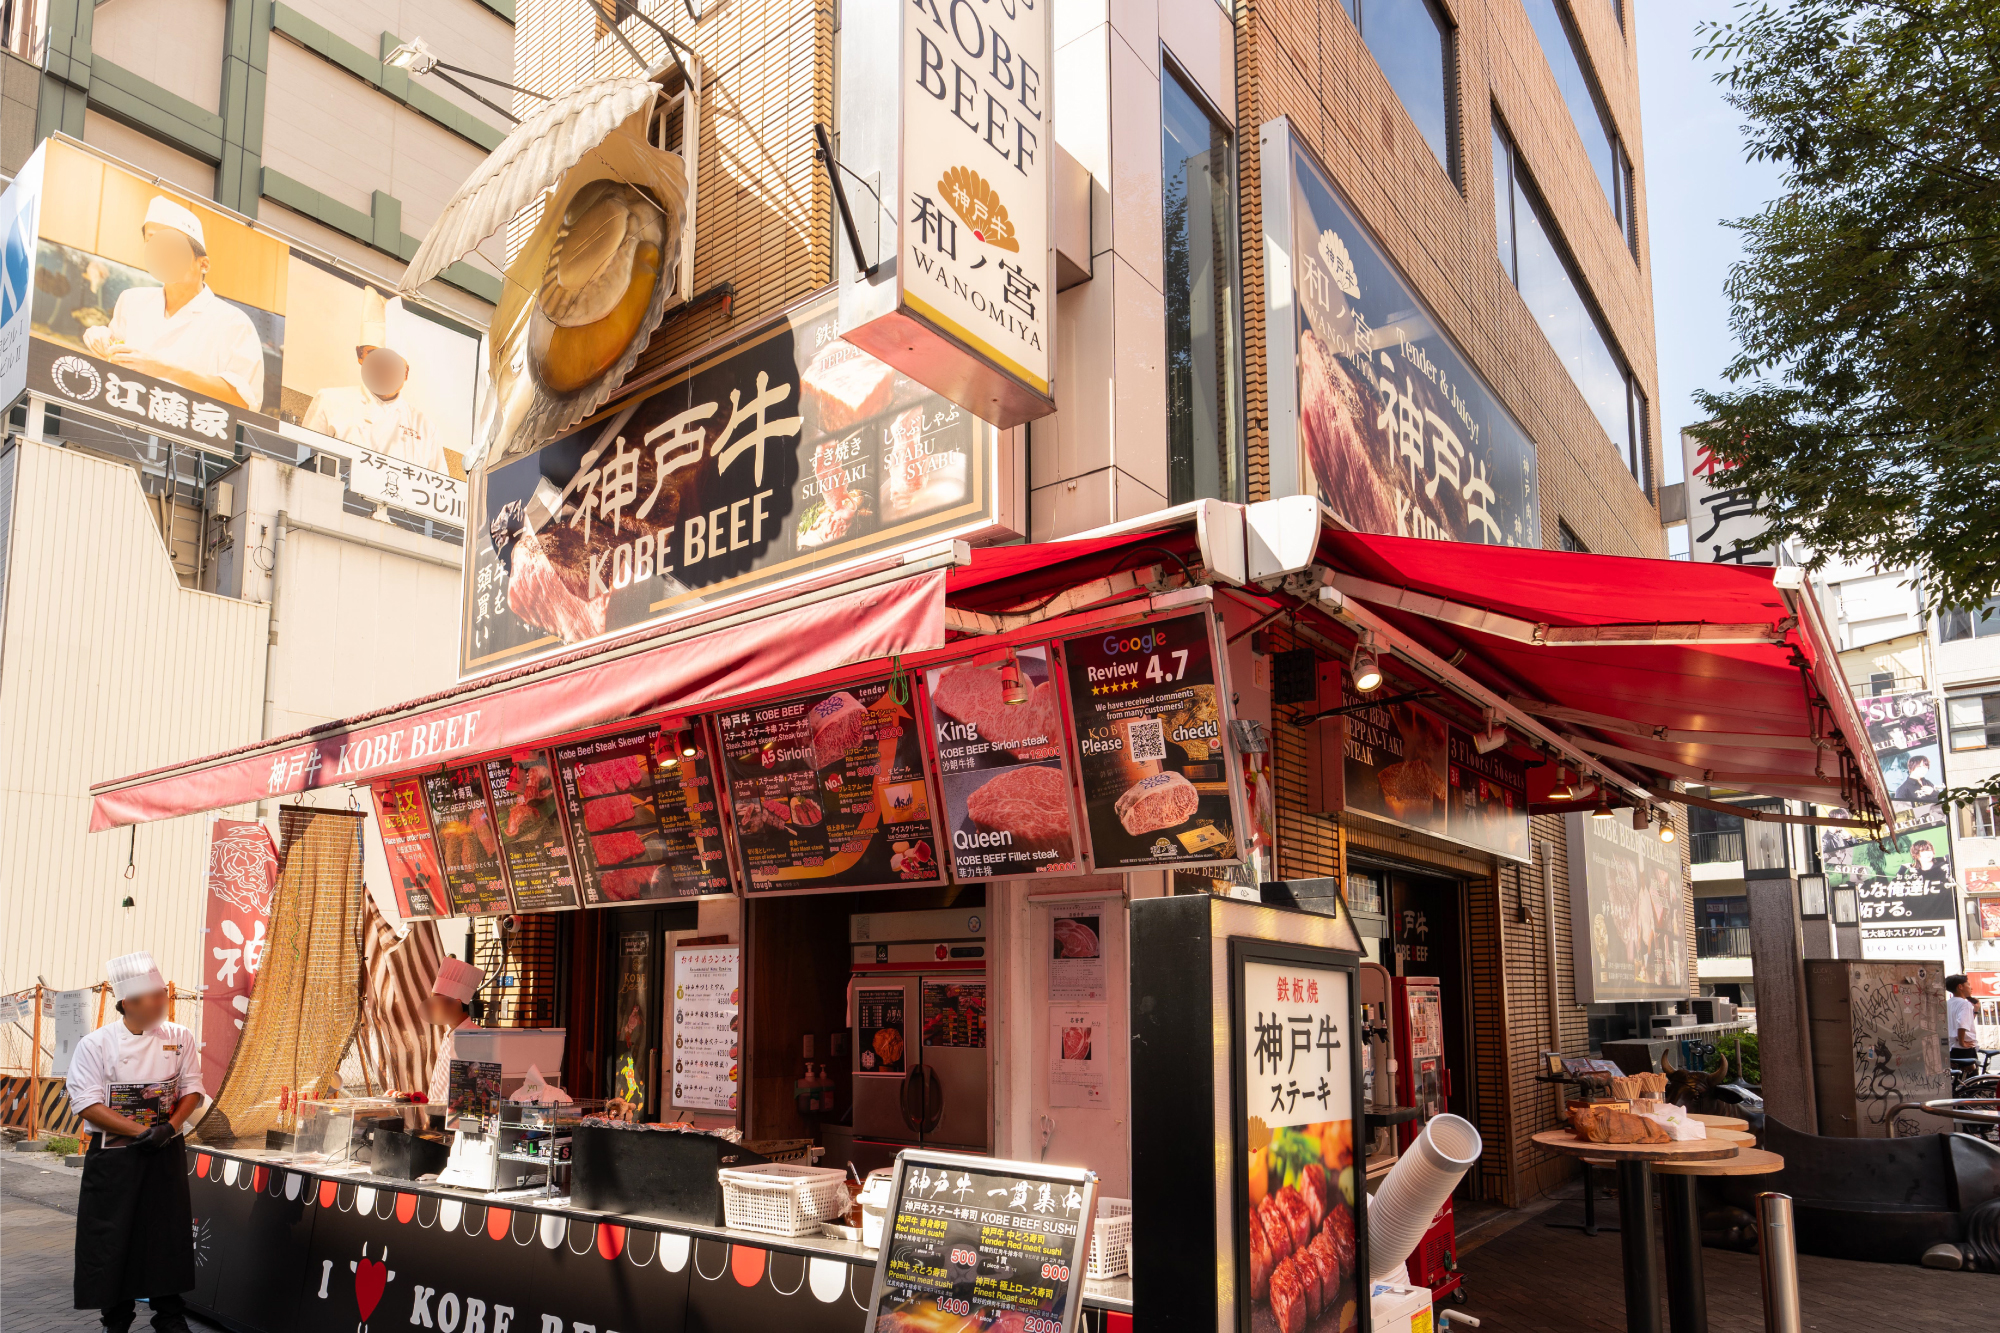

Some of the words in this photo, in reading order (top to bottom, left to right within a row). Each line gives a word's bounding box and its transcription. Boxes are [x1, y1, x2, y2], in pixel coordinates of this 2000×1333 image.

[912, 0, 1042, 121] OBE
[916, 27, 1037, 177] BEEF
[951, 183, 1008, 241] 神戸牛
[910, 191, 1041, 321] 和ノ宮
[1325, 243, 1354, 286] 神戸牛
[911, 245, 1042, 352] WANOMIYA
[1303, 254, 1374, 362] 和ノ宮
[1306, 300, 1375, 386] WANOMIYA
[820, 345, 866, 372] TEPPA
[1396, 326, 1438, 382] Tender
[1440, 371, 1449, 396] &
[1451, 382, 1480, 444] Juicy!
[105, 372, 229, 441] 江藤家
[883, 404, 960, 445] しゃぶしゃぶ
[570, 371, 804, 545] 神戸牛
[809, 437, 862, 472] すき焼き
[883, 438, 936, 471] SYABU
[1377, 351, 1502, 545] 神戸牛
[360, 451, 457, 493] ステーキハウス
[802, 463, 867, 500] SUKIYAKI
[412, 488, 466, 520] つじ川
[1396, 488, 1451, 541] KOB
[589, 525, 675, 599] KOBE
[683, 488, 773, 567] BEEF
[474, 545, 494, 648] 一頭買い
[1102, 627, 1168, 656] Google
[1087, 660, 1139, 682] Review
[1145, 648, 1189, 684] 4.7
[859, 685, 886, 697] tender
[1095, 703, 1107, 712] We
[1107, 699, 1124, 710] have
[1125, 696, 1155, 708] received
[1155, 690, 1194, 702] comments
[721, 712, 751, 730] 神戸牛
[755, 709, 780, 722] KOBE
[781, 704, 805, 717] BEEF
[1106, 711, 1123, 720] from
[1124, 708, 1144, 718] many
[1144, 700, 1184, 714] customers!
[1369, 706, 1392, 731] BEEF
[1869, 700, 1924, 723] SUO
[724, 731, 747, 742] ステーキ
[748, 724, 777, 738] ステーキ串
[779, 718, 809, 732] ステーキ丼
[796, 729, 810, 738] bowl
[875, 726, 903, 740] 12000
[937, 720, 978, 743] King
[1081, 738, 1122, 754] Please
[1172, 720, 1219, 742] check!
[1343, 715, 1403, 757] TEPPAN-YAKI
[335, 730, 404, 776] KOBE
[409, 710, 481, 759] BEEF
[558, 747, 576, 760] Kobe
[577, 743, 594, 756] Beef
[595, 739, 617, 753] Steak
[618, 734, 645, 747] Skewer
[940, 748, 965, 760] KOBE
[966, 743, 990, 755] BEEF
[991, 738, 1020, 751] Sirloin
[1022, 734, 1049, 748] steak
[1344, 738, 1375, 767] STEAK
[762, 750, 775, 766] A5
[777, 745, 812, 762] Sirloin
[942, 758, 976, 772] 沙朗牛排
[268, 748, 322, 793] 神戸牛
[573, 763, 586, 779] A5
[758, 775, 785, 786] ステーキ串
[787, 770, 814, 782] ステーキ丼
[857, 765, 880, 777] 9800
[888, 766, 911, 775] 生ビール
[1450, 769, 1458, 783] 3F
[734, 780, 754, 790] ステーキ
[824, 774, 844, 791] No.1
[1480, 780, 1488, 796] 2F
[451, 802, 466, 813] BEEF
[852, 802, 875, 814] 5500
[1504, 793, 1512, 806] 1F
[385, 812, 420, 829] はこちらから
[384, 837, 396, 845] Place
[406, 834, 418, 843] order
[562, 768, 580, 816] 神戸牛
[574, 822, 599, 903] ステーキ串
[953, 829, 1013, 850] Queen
[1593, 815, 1618, 844] KOBE
[1640, 836, 1665, 865] STEAK
[841, 842, 863, 853] 4300
[956, 854, 979, 866] KOBE
[980, 852, 1007, 865] BEEF
[1008, 850, 1031, 862] Fillet
[1032, 849, 1060, 860] steak
[1046, 861, 1077, 873] 20000
[1834, 865, 1868, 875] SORA
[679, 887, 698, 896] tough
[753, 880, 773, 890] tough
[1839, 879, 1941, 899] んな俺達に
[415, 902, 429, 910] HERE
[1862, 927, 1941, 938] 最大級ホストグループ
[1411, 945, 1428, 962] BEEF
[1896, 943, 1948, 952] GROUP
[1276, 975, 1319, 1004] 鉄板焼
[1254, 1011, 1341, 1076] 神戸牛
[1270, 1077, 1331, 1115] ステーキ
[529, 1142, 537, 1154] L
[562, 1147, 570, 1159] S
[908, 1167, 974, 1203] 神戸牛
[986, 1180, 1083, 1218] 一貫集中
[897, 1214, 918, 1226] 神戸牛
[904, 1199, 978, 1222] 神戸牛ステーキ寿司
[980, 1211, 1011, 1226] KOBE
[1012, 1216, 1040, 1230] BEEF
[1042, 1220, 1077, 1236] SUSHI
[895, 1223, 909, 1233] Red
[909, 1227, 927, 1236] meat
[927, 1229, 945, 1239] sushi
[982, 1226, 1005, 1238] 神戸牛
[1006, 1230, 1045, 1245] 中とろ寿司
[980, 1235, 1006, 1248] Tender
[1006, 1240, 1022, 1250] Red
[1022, 1243, 1041, 1253] meat
[1042, 1247, 1063, 1256] sushi
[951, 1248, 976, 1267] 500
[888, 1269, 916, 1282] Premium
[917, 1275, 934, 1285] meat
[934, 1279, 954, 1289] sushi
[889, 1260, 911, 1271] 神戸牛
[911, 1264, 948, 1279] 大とろ寿司
[1041, 1263, 1070, 1282] 900
[973, 1286, 996, 1299] Finest
[996, 1291, 1018, 1303] Roast
[1018, 1296, 1039, 1307] sushi
[975, 1276, 998, 1289] 神戸牛
[999, 1280, 1054, 1299] 極上ロース寿司
[937, 1296, 969, 1316] 1400
[1024, 1315, 1062, 1333] 2000
